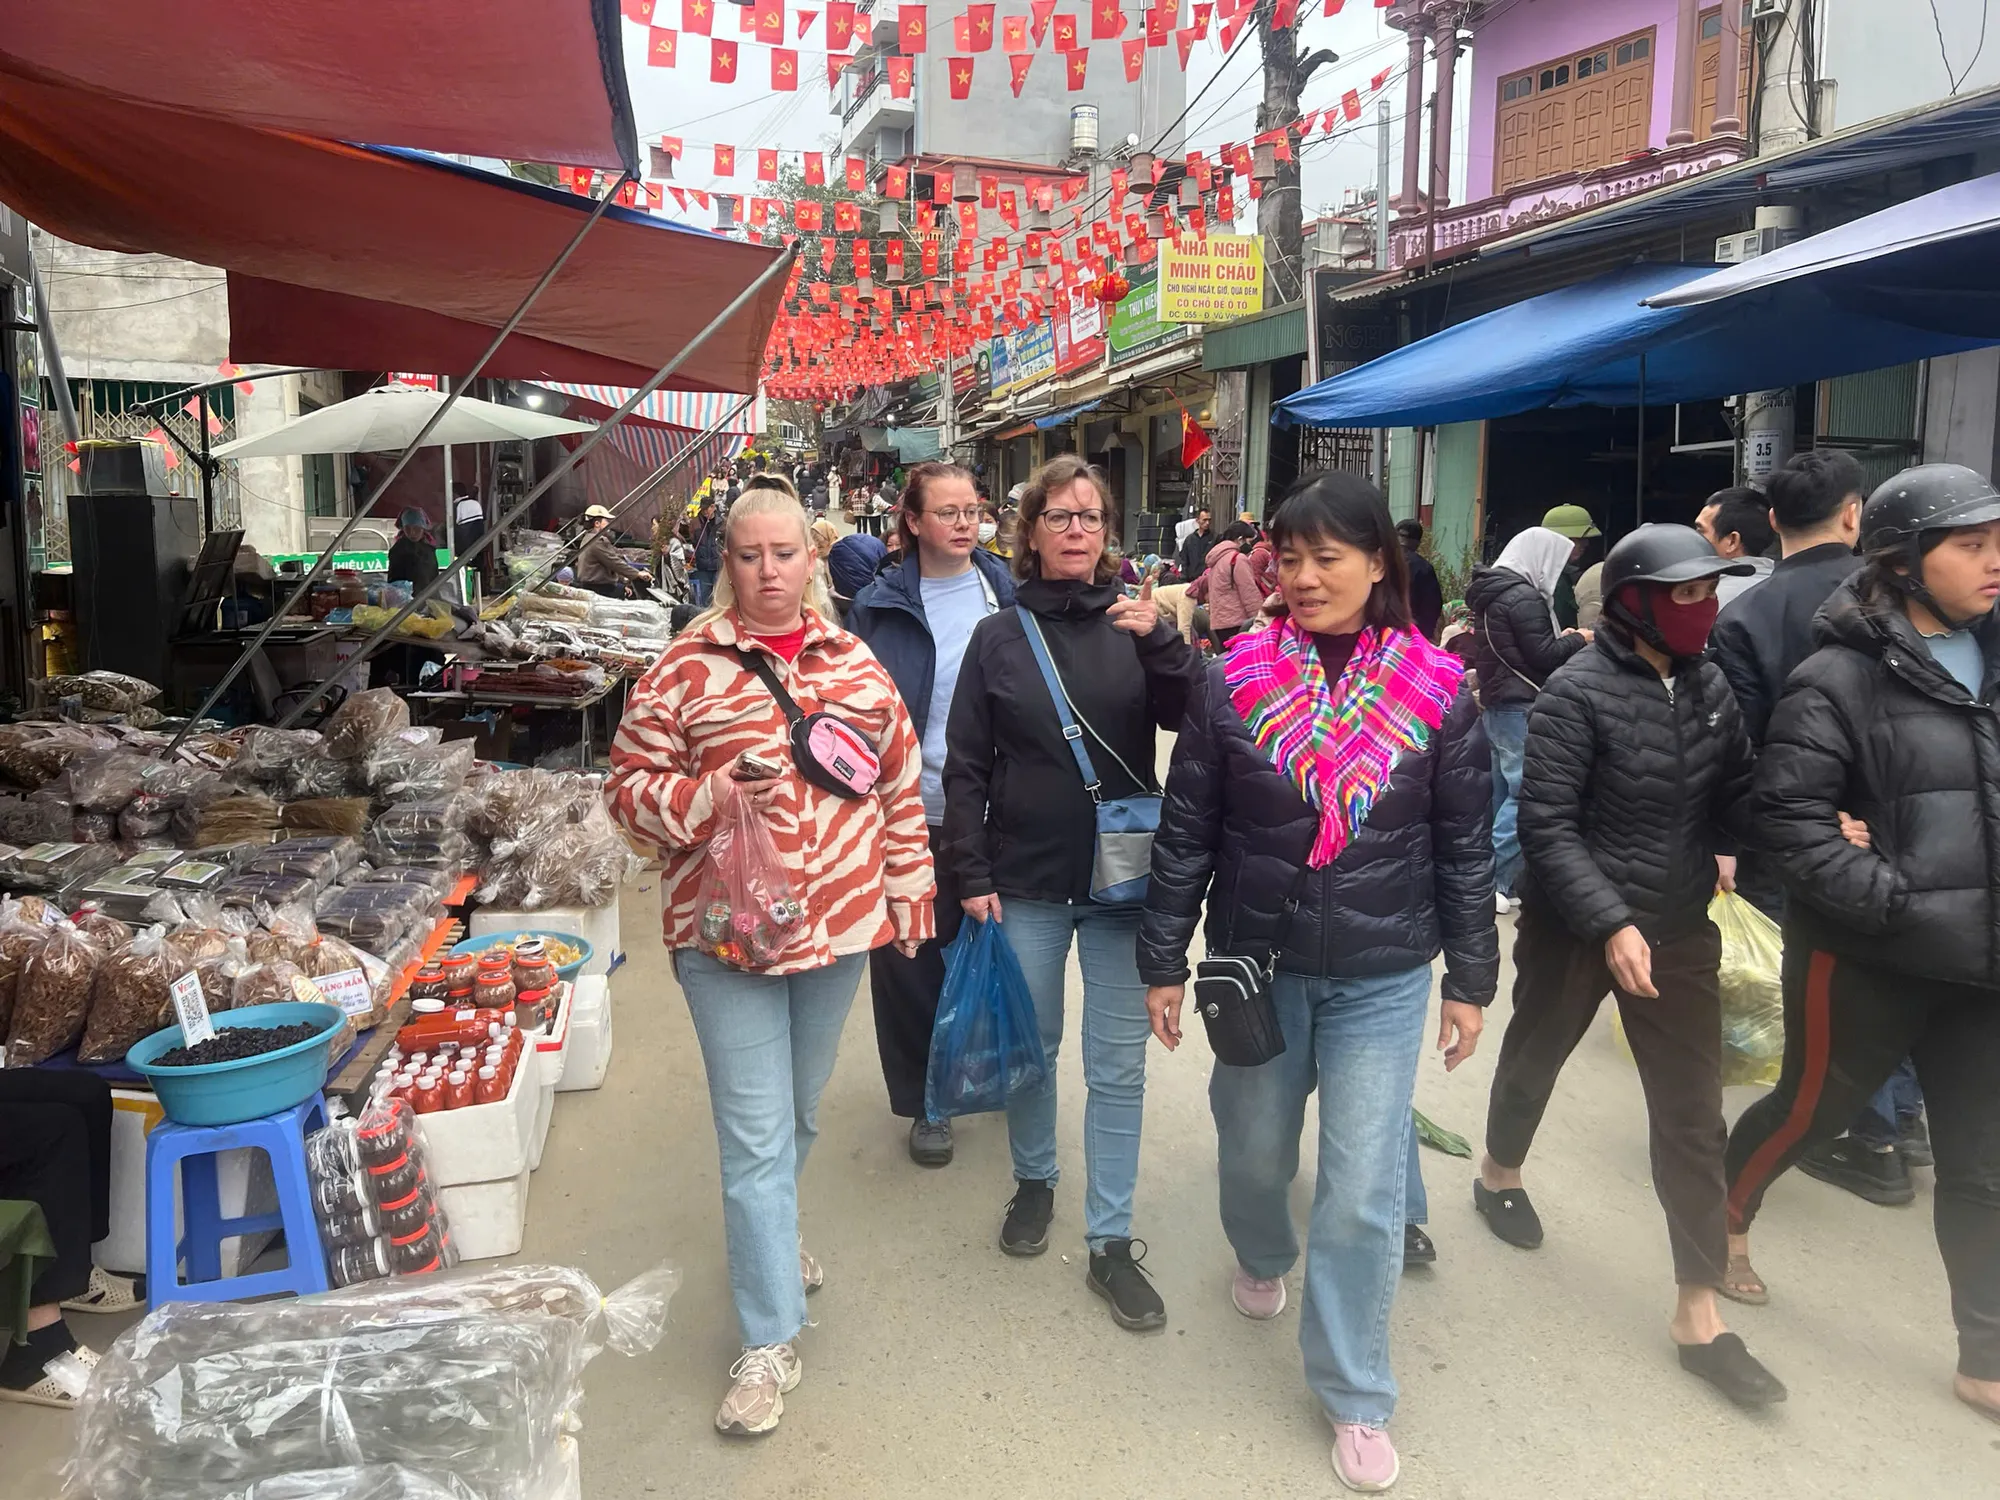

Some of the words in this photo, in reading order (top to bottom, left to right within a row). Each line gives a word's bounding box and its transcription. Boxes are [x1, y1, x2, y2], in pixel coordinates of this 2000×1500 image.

[1169, 262, 1211, 279] MINH
[1216, 262, 1256, 281] CHÂU
[1167, 283, 1180, 293] CHO
[1756, 442, 1772, 457] 3.5
[367, 559, 384, 570] VÀ
